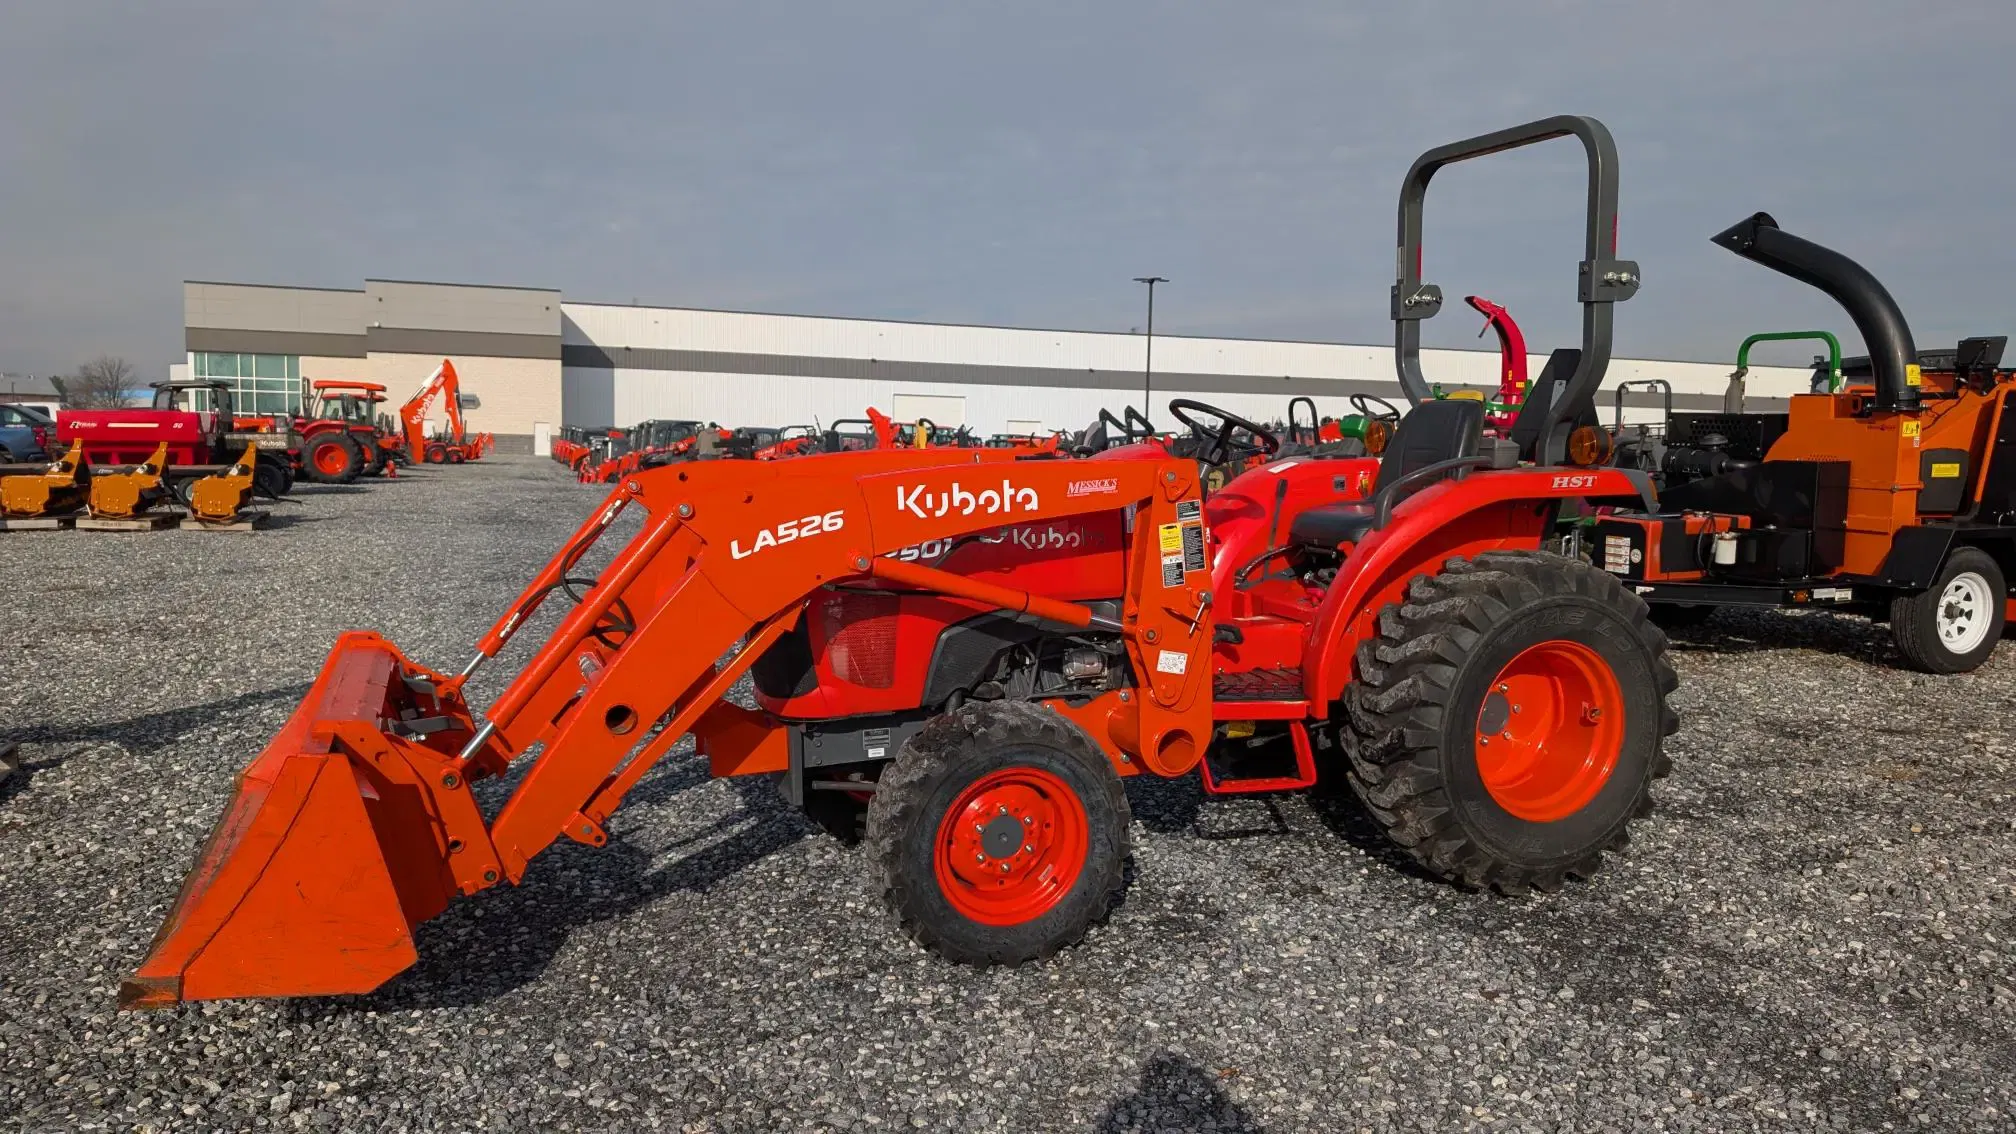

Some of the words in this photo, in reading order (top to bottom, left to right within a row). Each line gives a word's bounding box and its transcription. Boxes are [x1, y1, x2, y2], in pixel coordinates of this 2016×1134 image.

[1066, 478, 1118, 494] MESSICK'S
[1552, 474, 1598, 488] HST
[897, 479, 1039, 518] Kubota
[731, 510, 844, 560] LA526
[1012, 527, 1104, 550] Kubo
[885, 537, 952, 562] 501
